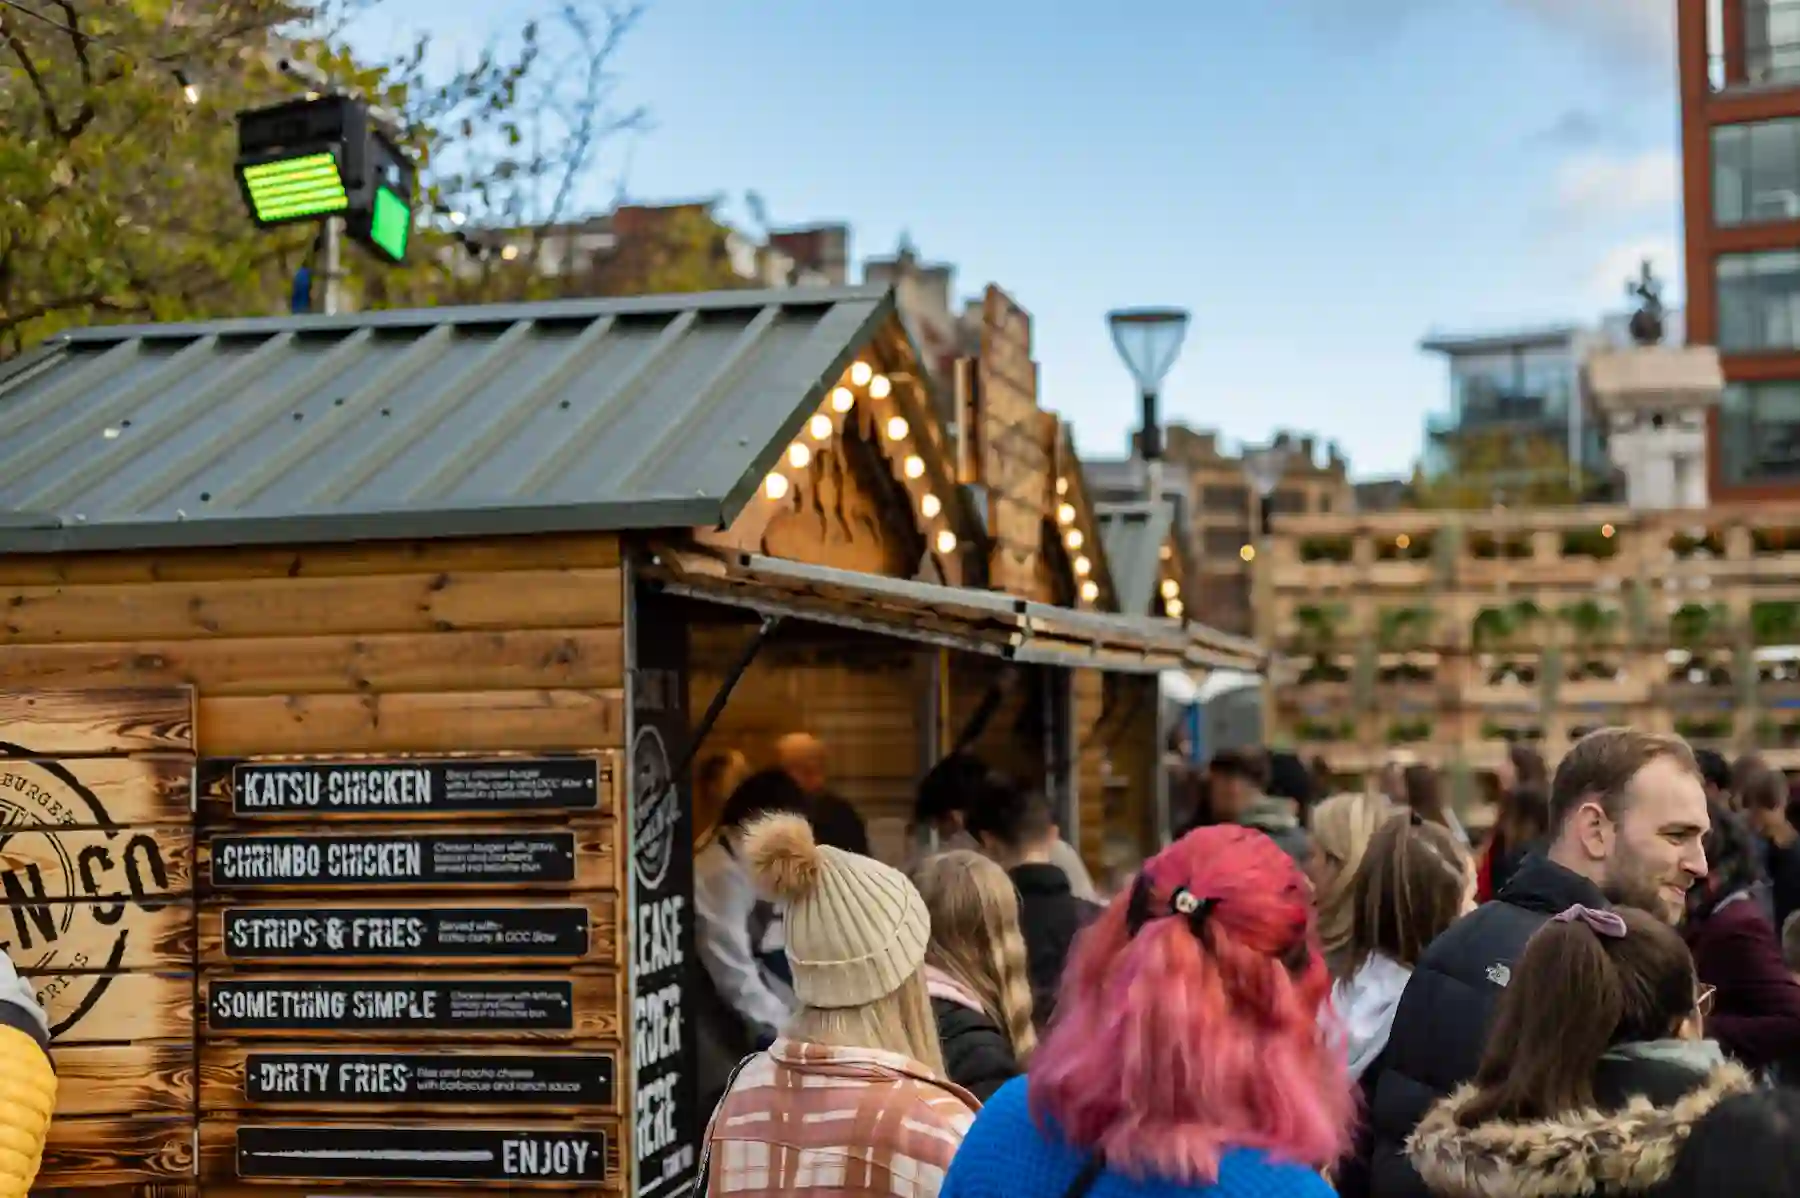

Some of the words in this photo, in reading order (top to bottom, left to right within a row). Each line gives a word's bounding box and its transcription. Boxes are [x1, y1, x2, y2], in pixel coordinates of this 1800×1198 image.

[245, 772, 321, 806] KATSU
[328, 770, 432, 805] CHICKEN
[223, 844, 320, 878] CHRIMBO
[328, 841, 421, 876] CHICKEN
[234, 918, 319, 948] STRIPS
[326, 917, 346, 950] &
[352, 917, 424, 948] FRIES
[217, 990, 346, 1019] SOMETHING
[353, 990, 437, 1019] SIMPLE
[260, 1063, 330, 1092] DIRTY
[339, 1063, 410, 1092] FRIES
[502, 1139, 590, 1176] ENJOY
